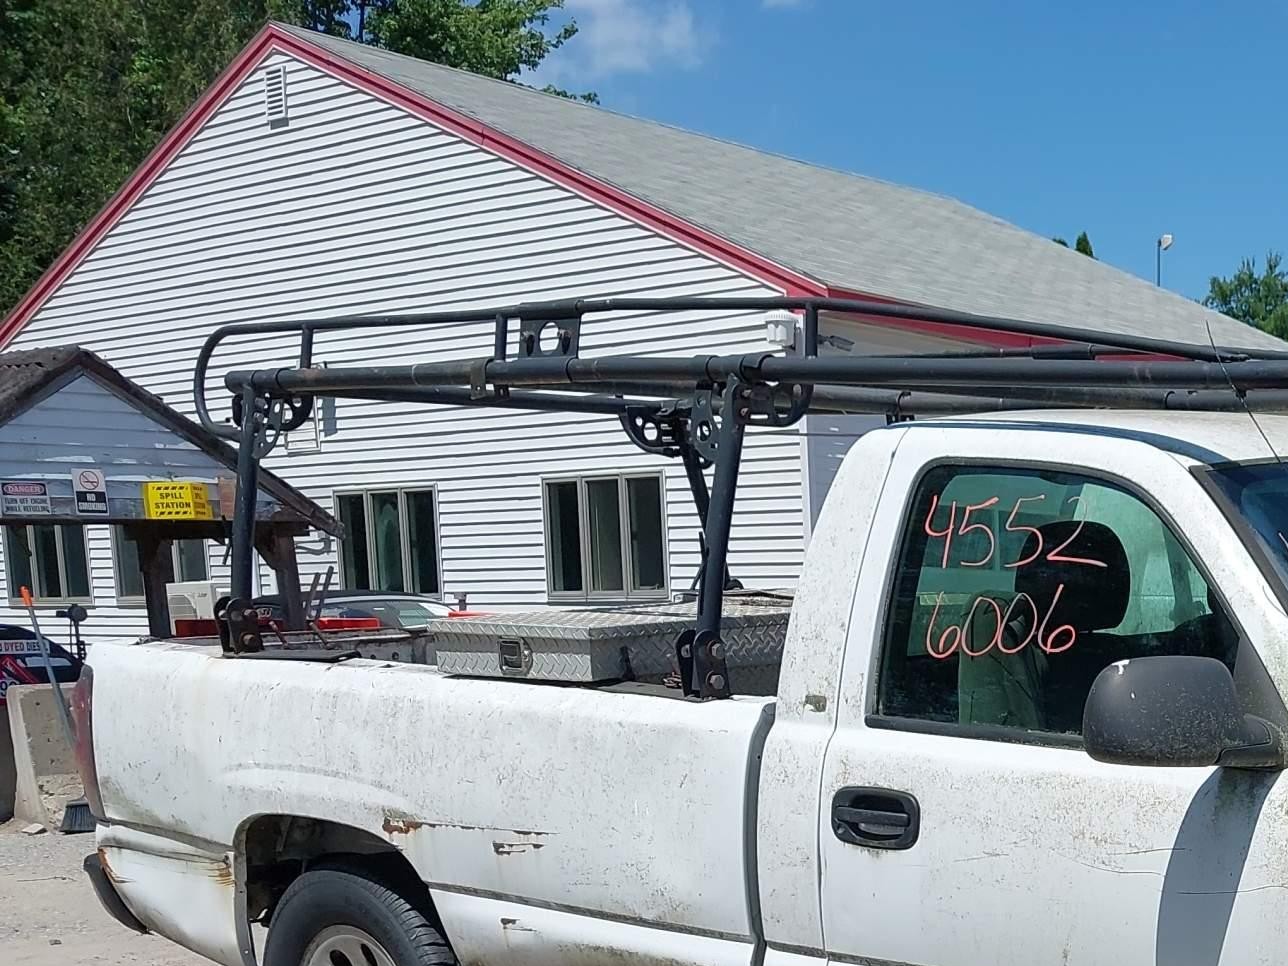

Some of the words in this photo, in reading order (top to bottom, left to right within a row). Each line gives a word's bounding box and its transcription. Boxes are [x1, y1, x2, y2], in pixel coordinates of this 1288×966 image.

[8, 485, 41, 493] DANGER
[924, 494, 1108, 569] 4552
[926, 583, 1076, 658] 6006
[4, 642, 24, 651] DYED
